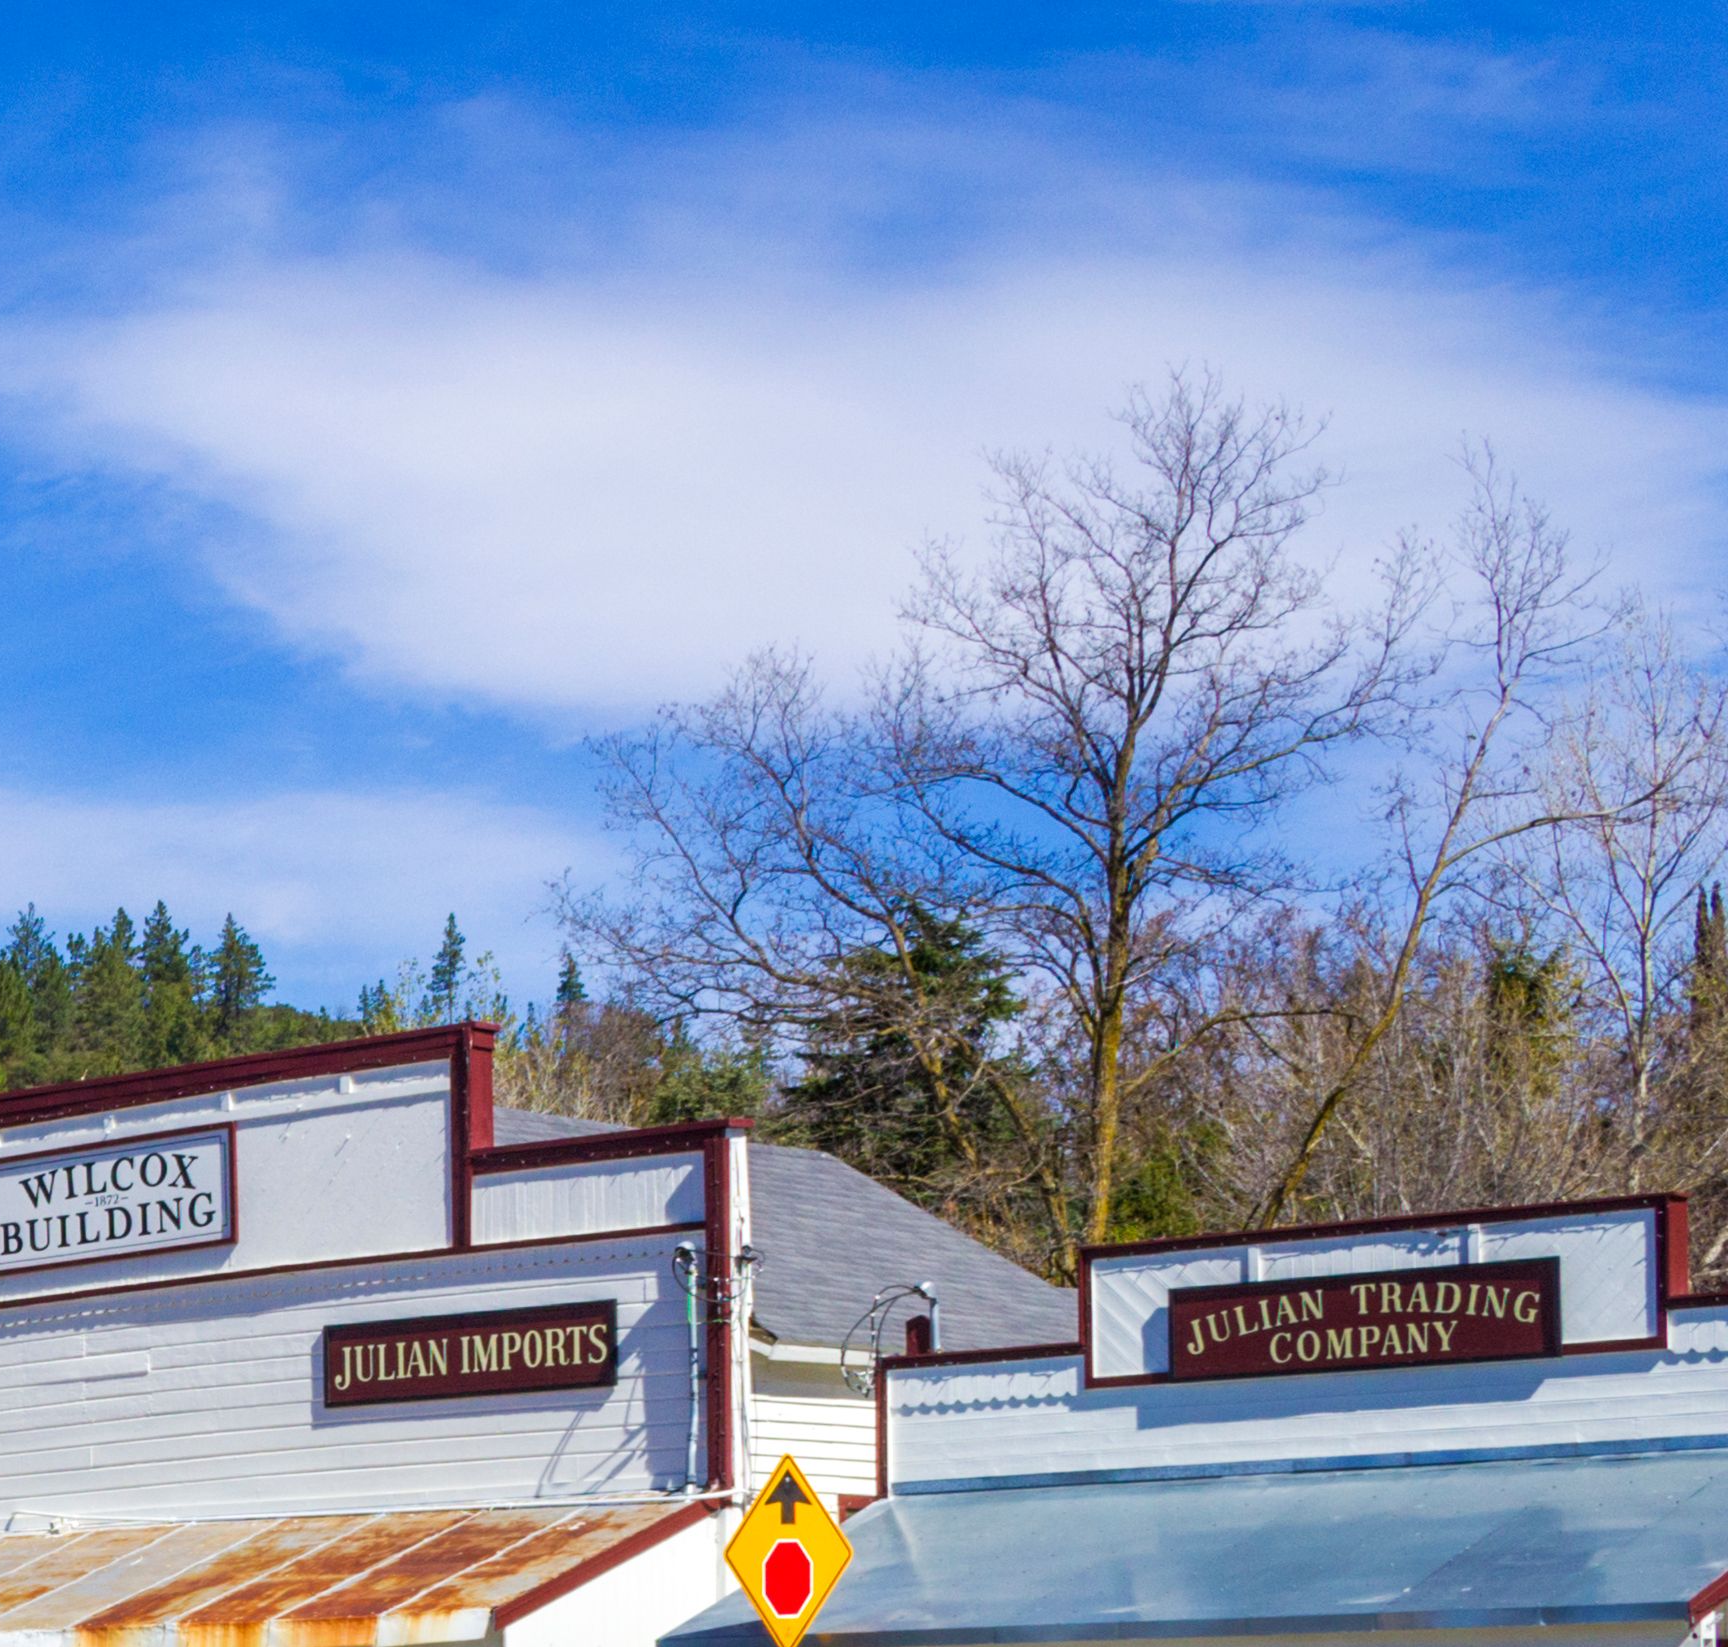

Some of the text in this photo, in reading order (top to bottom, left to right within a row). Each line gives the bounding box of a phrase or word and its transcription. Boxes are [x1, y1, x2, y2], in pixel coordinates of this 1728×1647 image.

[18, 1152, 199, 1209] WILCOX
[0, 1191, 217, 1257] BUILDING
[1186, 1281, 1541, 1356] JULIAN TRADING
[1268, 1318, 1458, 1365] COMPANY
[334, 1322, 609, 1391] JULIAN IMPORTS
